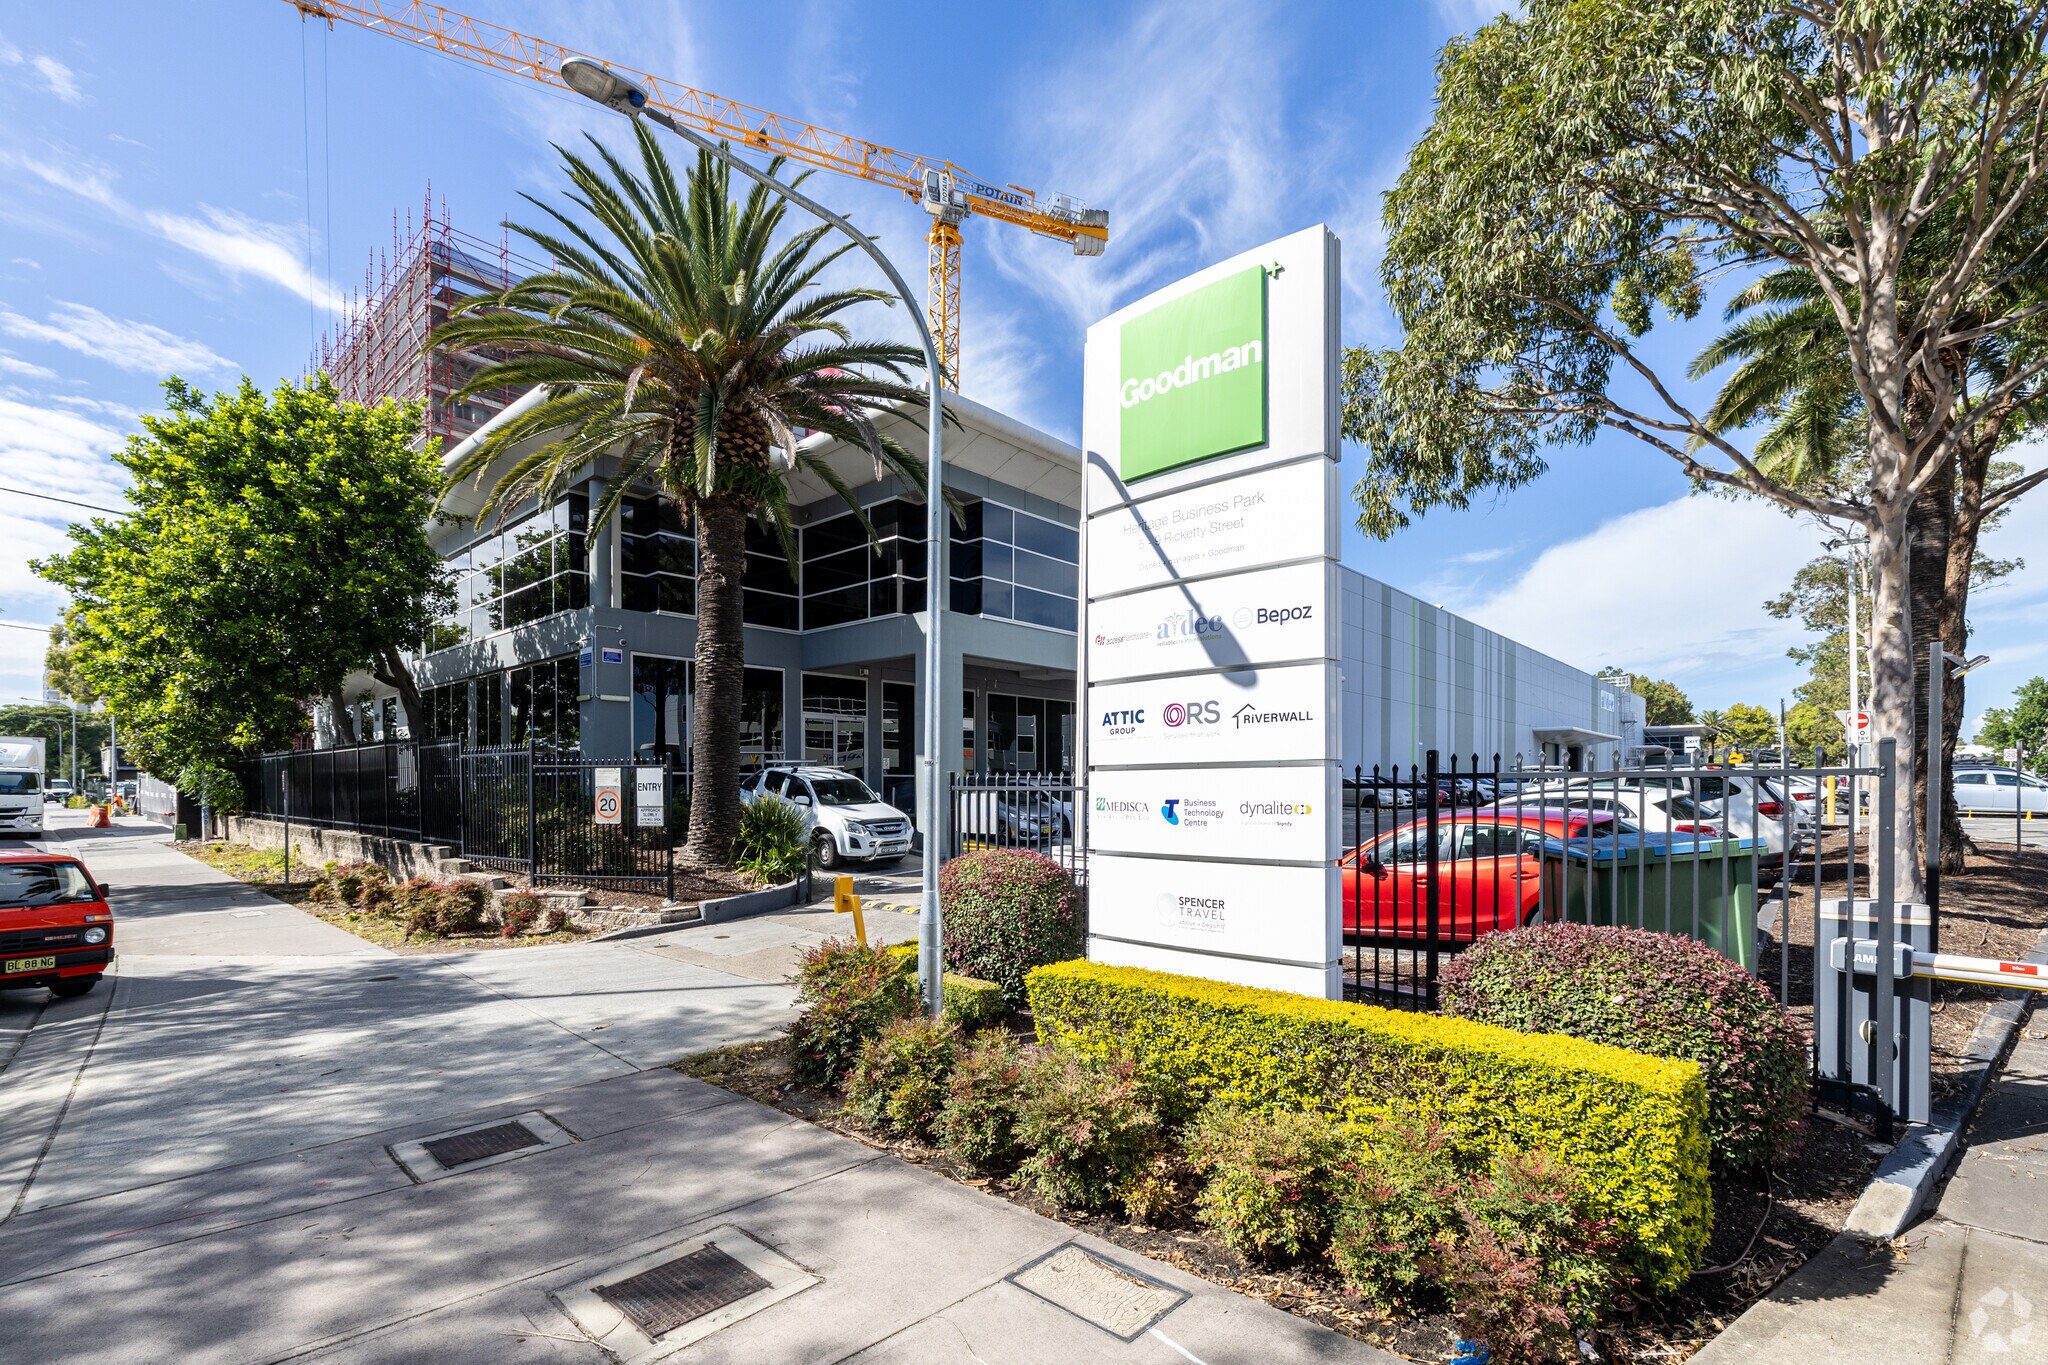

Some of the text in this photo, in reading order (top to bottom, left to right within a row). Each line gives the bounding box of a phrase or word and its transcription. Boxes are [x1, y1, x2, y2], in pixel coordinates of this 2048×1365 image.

[976, 183, 1023, 206] POTAIN
[1119, 339, 1262, 409] Goodman
[1123, 491, 1265, 536] Heritage Business Park
[1164, 526, 1207, 544] Ricketty
[1209, 517, 1244, 534] Street
[1208, 544, 1245, 558] Goodman
[1257, 605, 1313, 626] Bepoz
[1102, 708, 1145, 726] ATTIC
[1109, 726, 1136, 736] GROUP
[638, 782, 662, 792] ENTRY
[600, 798, 617, 812] 20
[1183, 798, 1217, 808] Business
[1239, 800, 1293, 818] dynalite
[1183, 808, 1224, 819] Technology
[1183, 818, 1208, 827] Centre
[1178, 896, 1225, 910] SPENCER
[1178, 907, 1225, 921] TRAVEL
